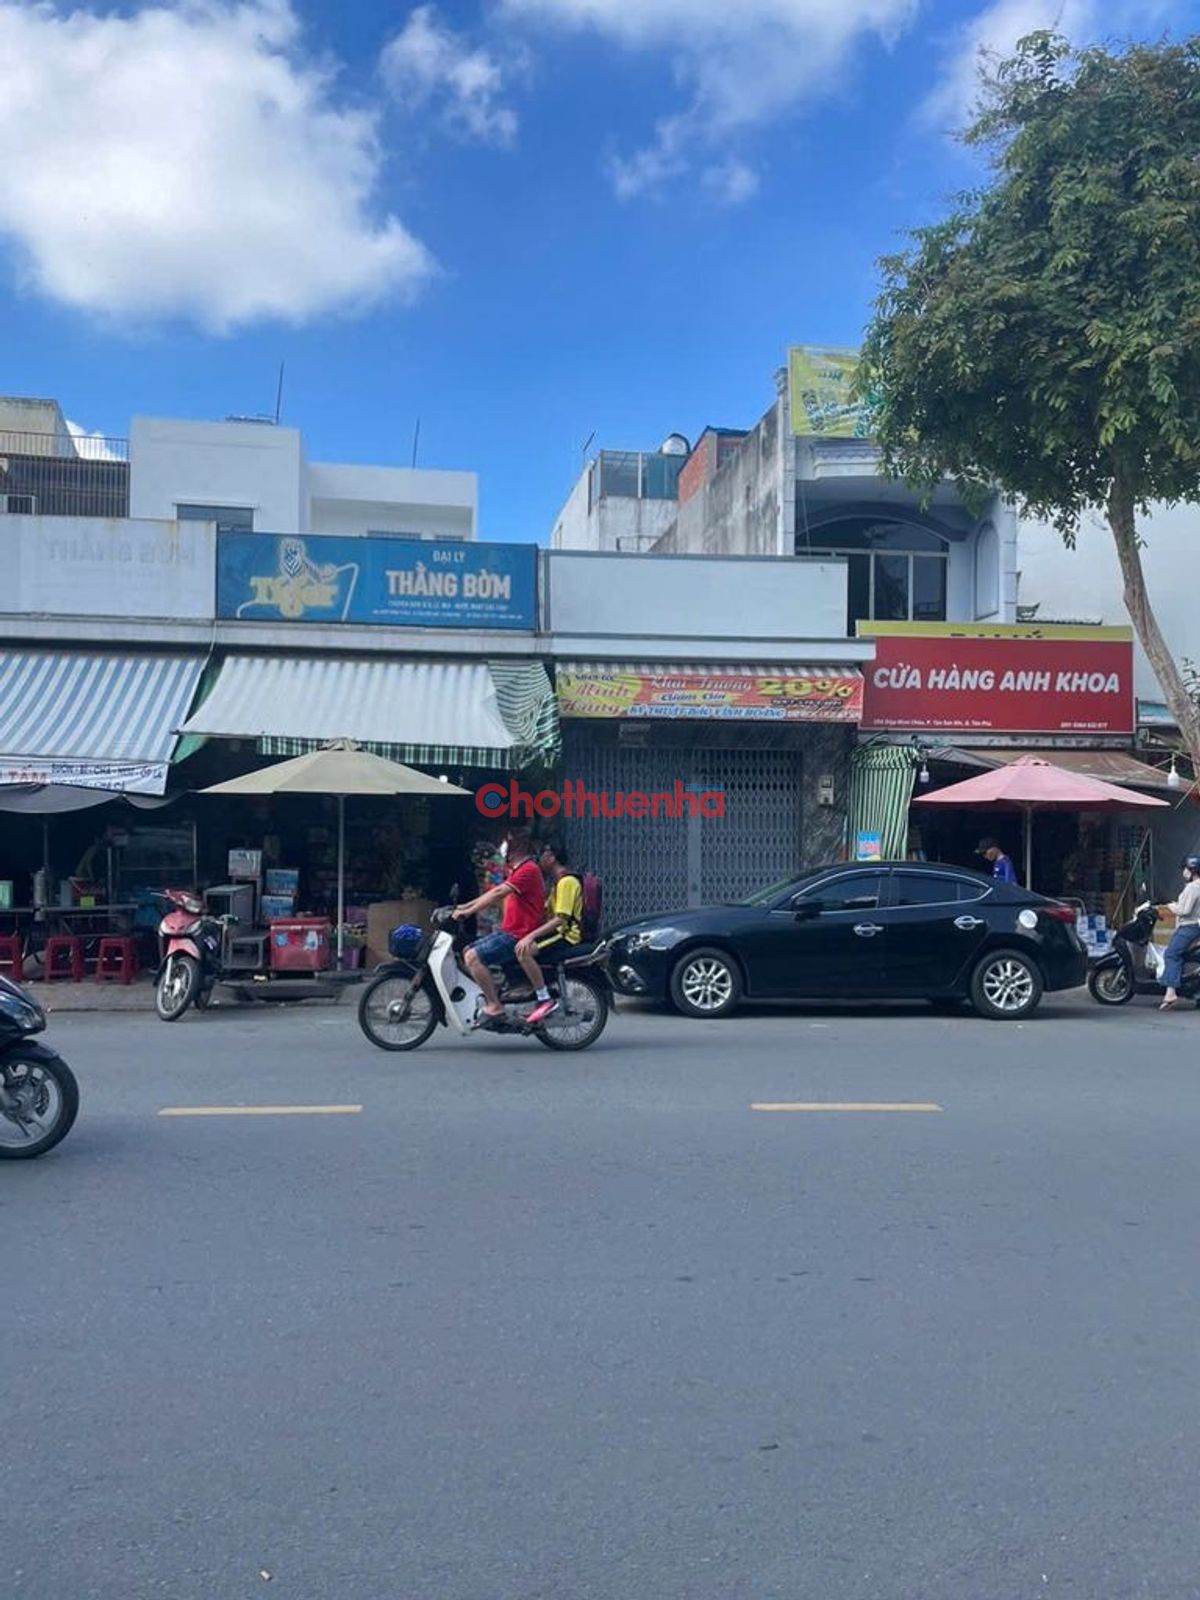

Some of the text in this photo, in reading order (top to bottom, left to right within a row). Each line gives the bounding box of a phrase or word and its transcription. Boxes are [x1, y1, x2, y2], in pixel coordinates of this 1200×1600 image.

[385, 561, 511, 600] THẰNG BỜM
[755, 677, 853, 697] 20%
[874, 662, 1120, 694] CỬA HÀNG ANH KHOA
